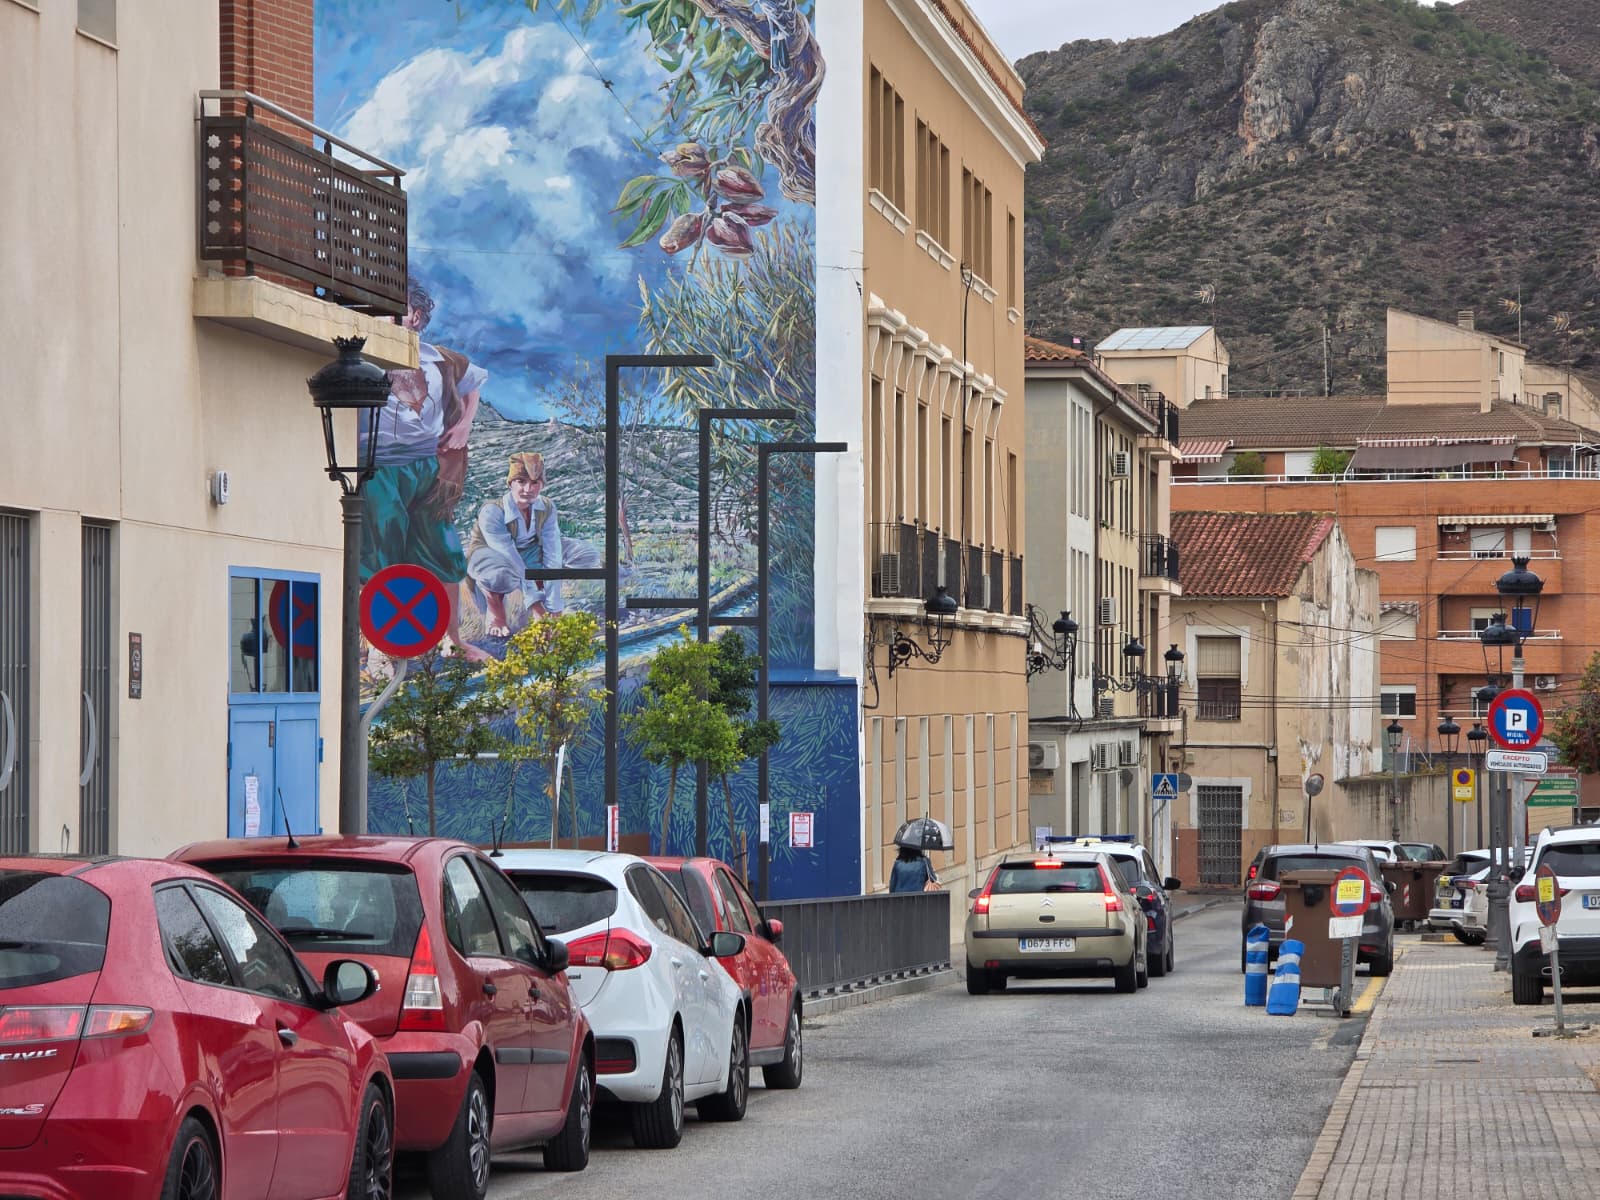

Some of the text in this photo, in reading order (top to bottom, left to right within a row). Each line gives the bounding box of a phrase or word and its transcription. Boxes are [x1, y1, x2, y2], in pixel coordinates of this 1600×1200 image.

[1512, 713, 1522, 726] P
[1027, 938, 1071, 948] 0673 FFC
[0, 1049, 57, 1060] CIVIC
